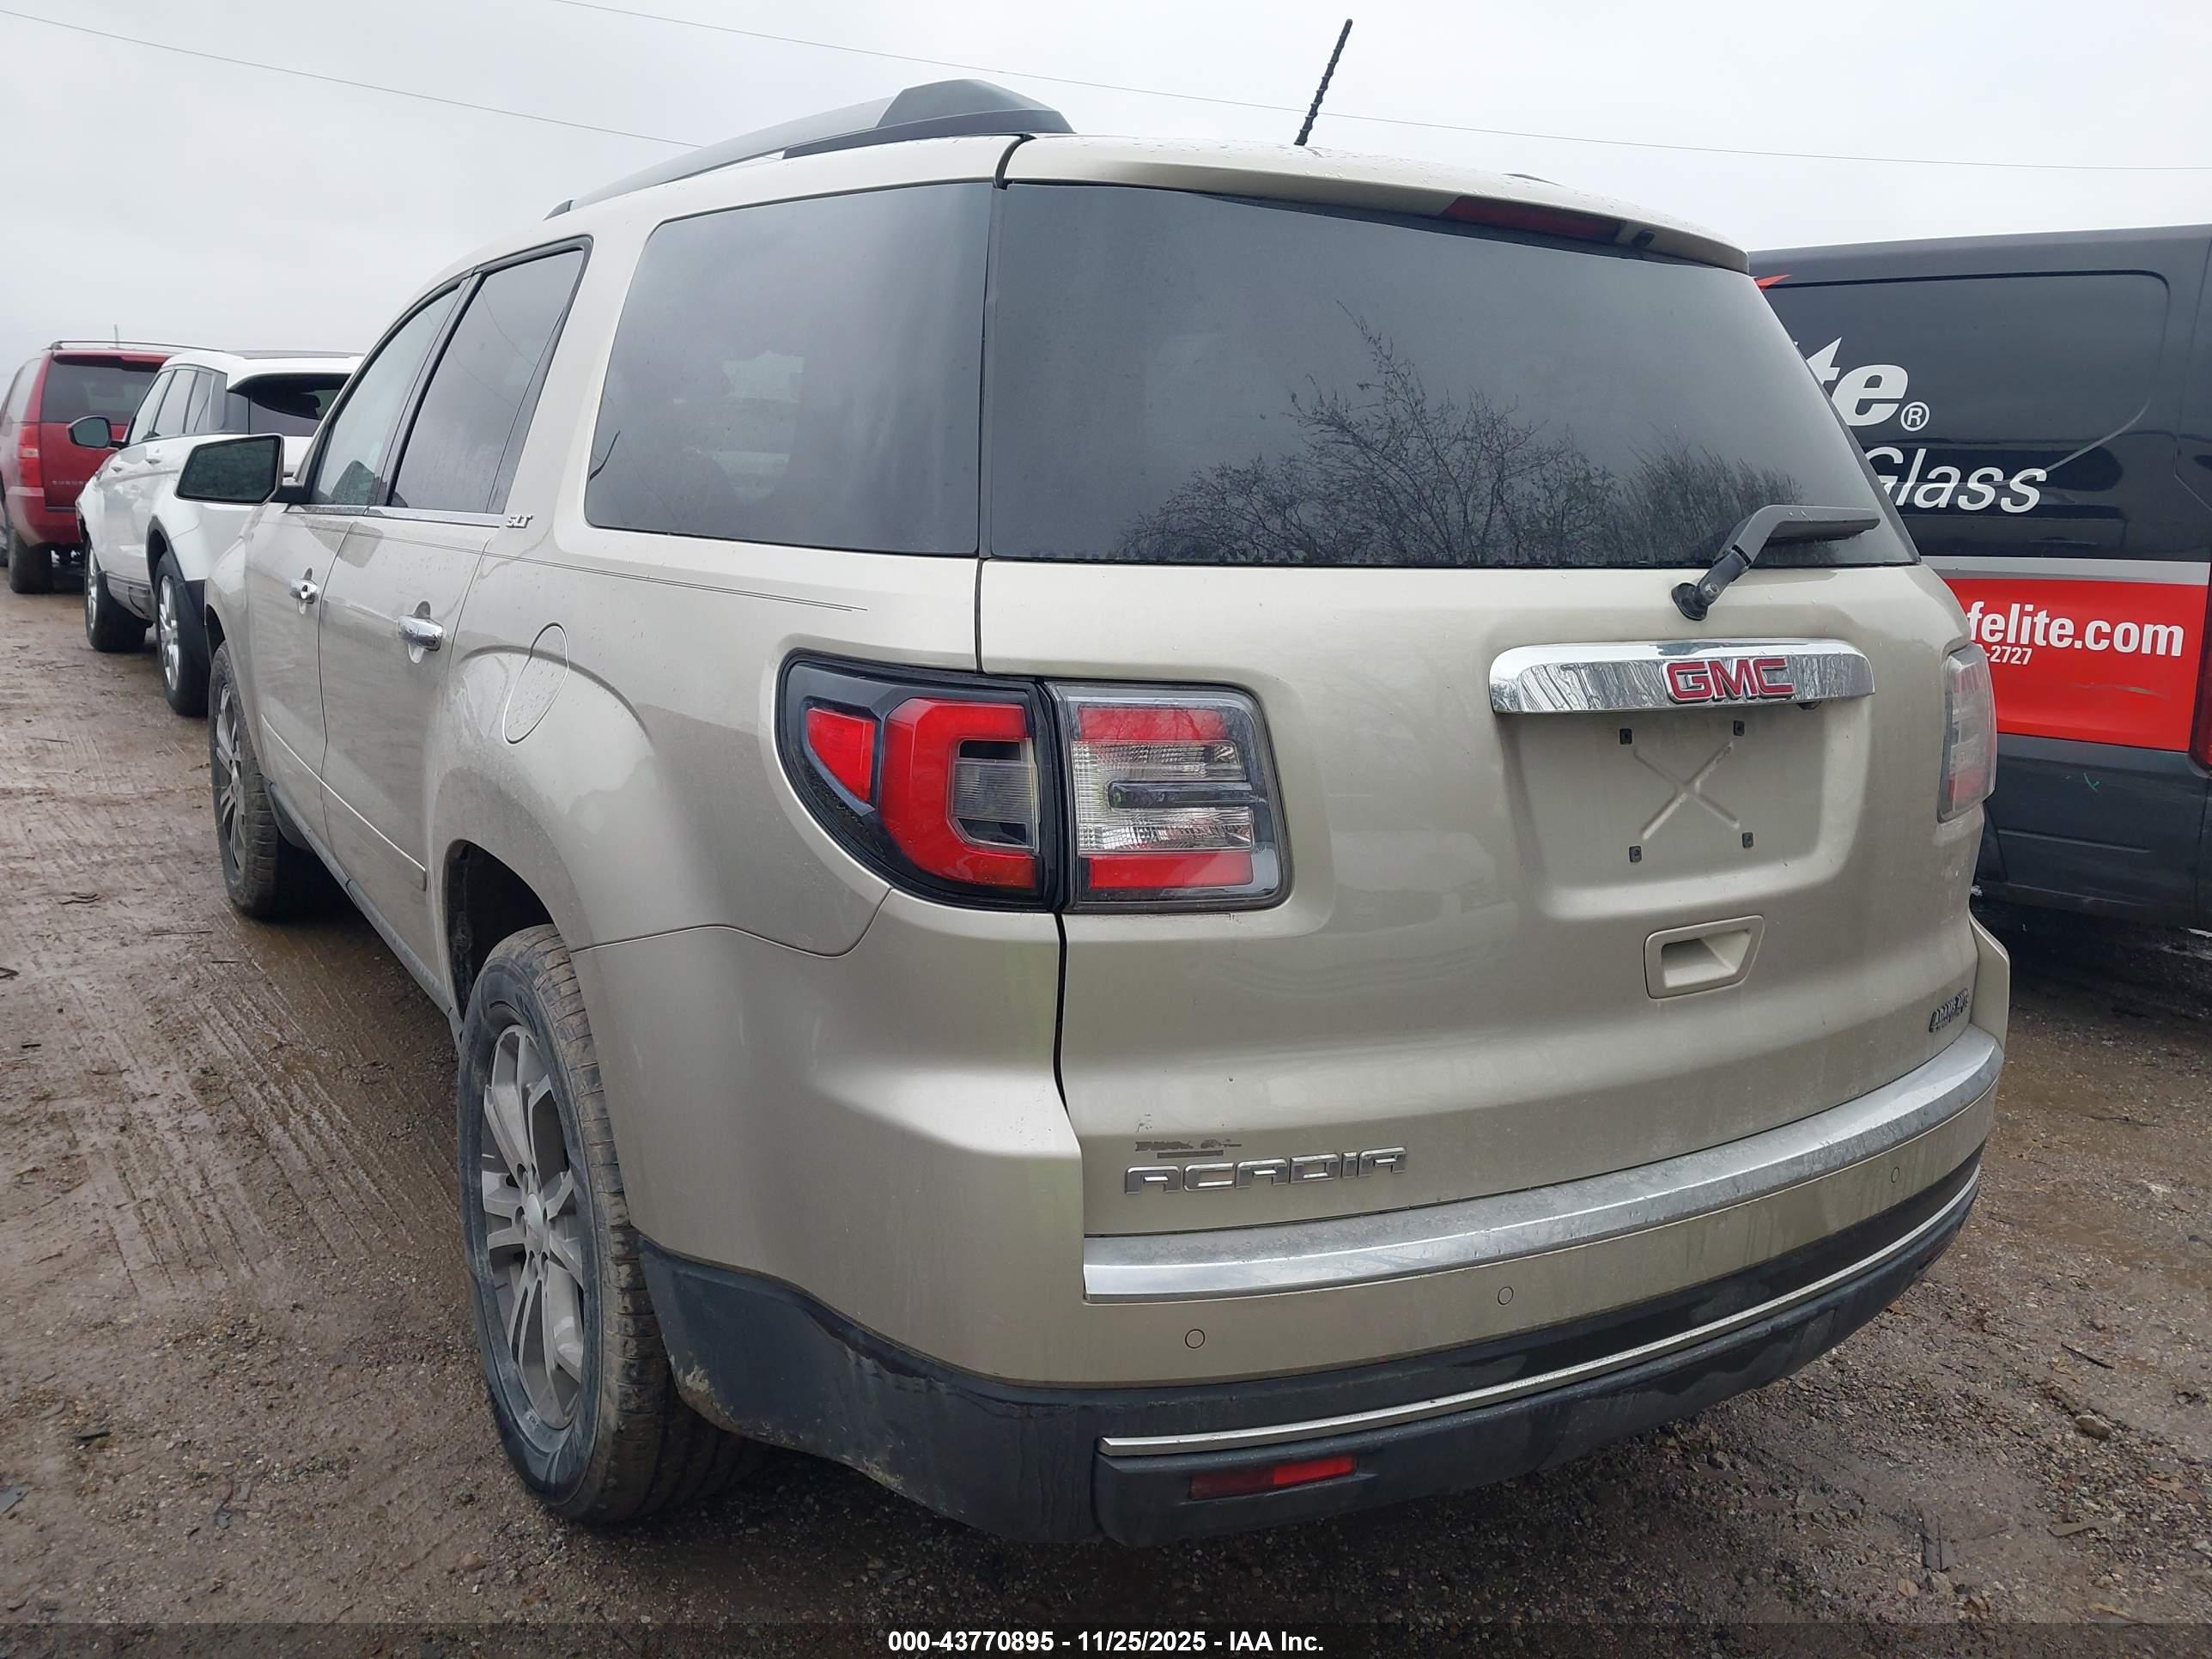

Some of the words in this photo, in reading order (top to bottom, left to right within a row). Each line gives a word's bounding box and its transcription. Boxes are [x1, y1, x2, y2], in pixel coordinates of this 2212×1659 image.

[1975, 643, 2033, 665] -2727
[1664, 657, 1796, 703] GMC
[1124, 1146, 1407, 1194] ACADIA
